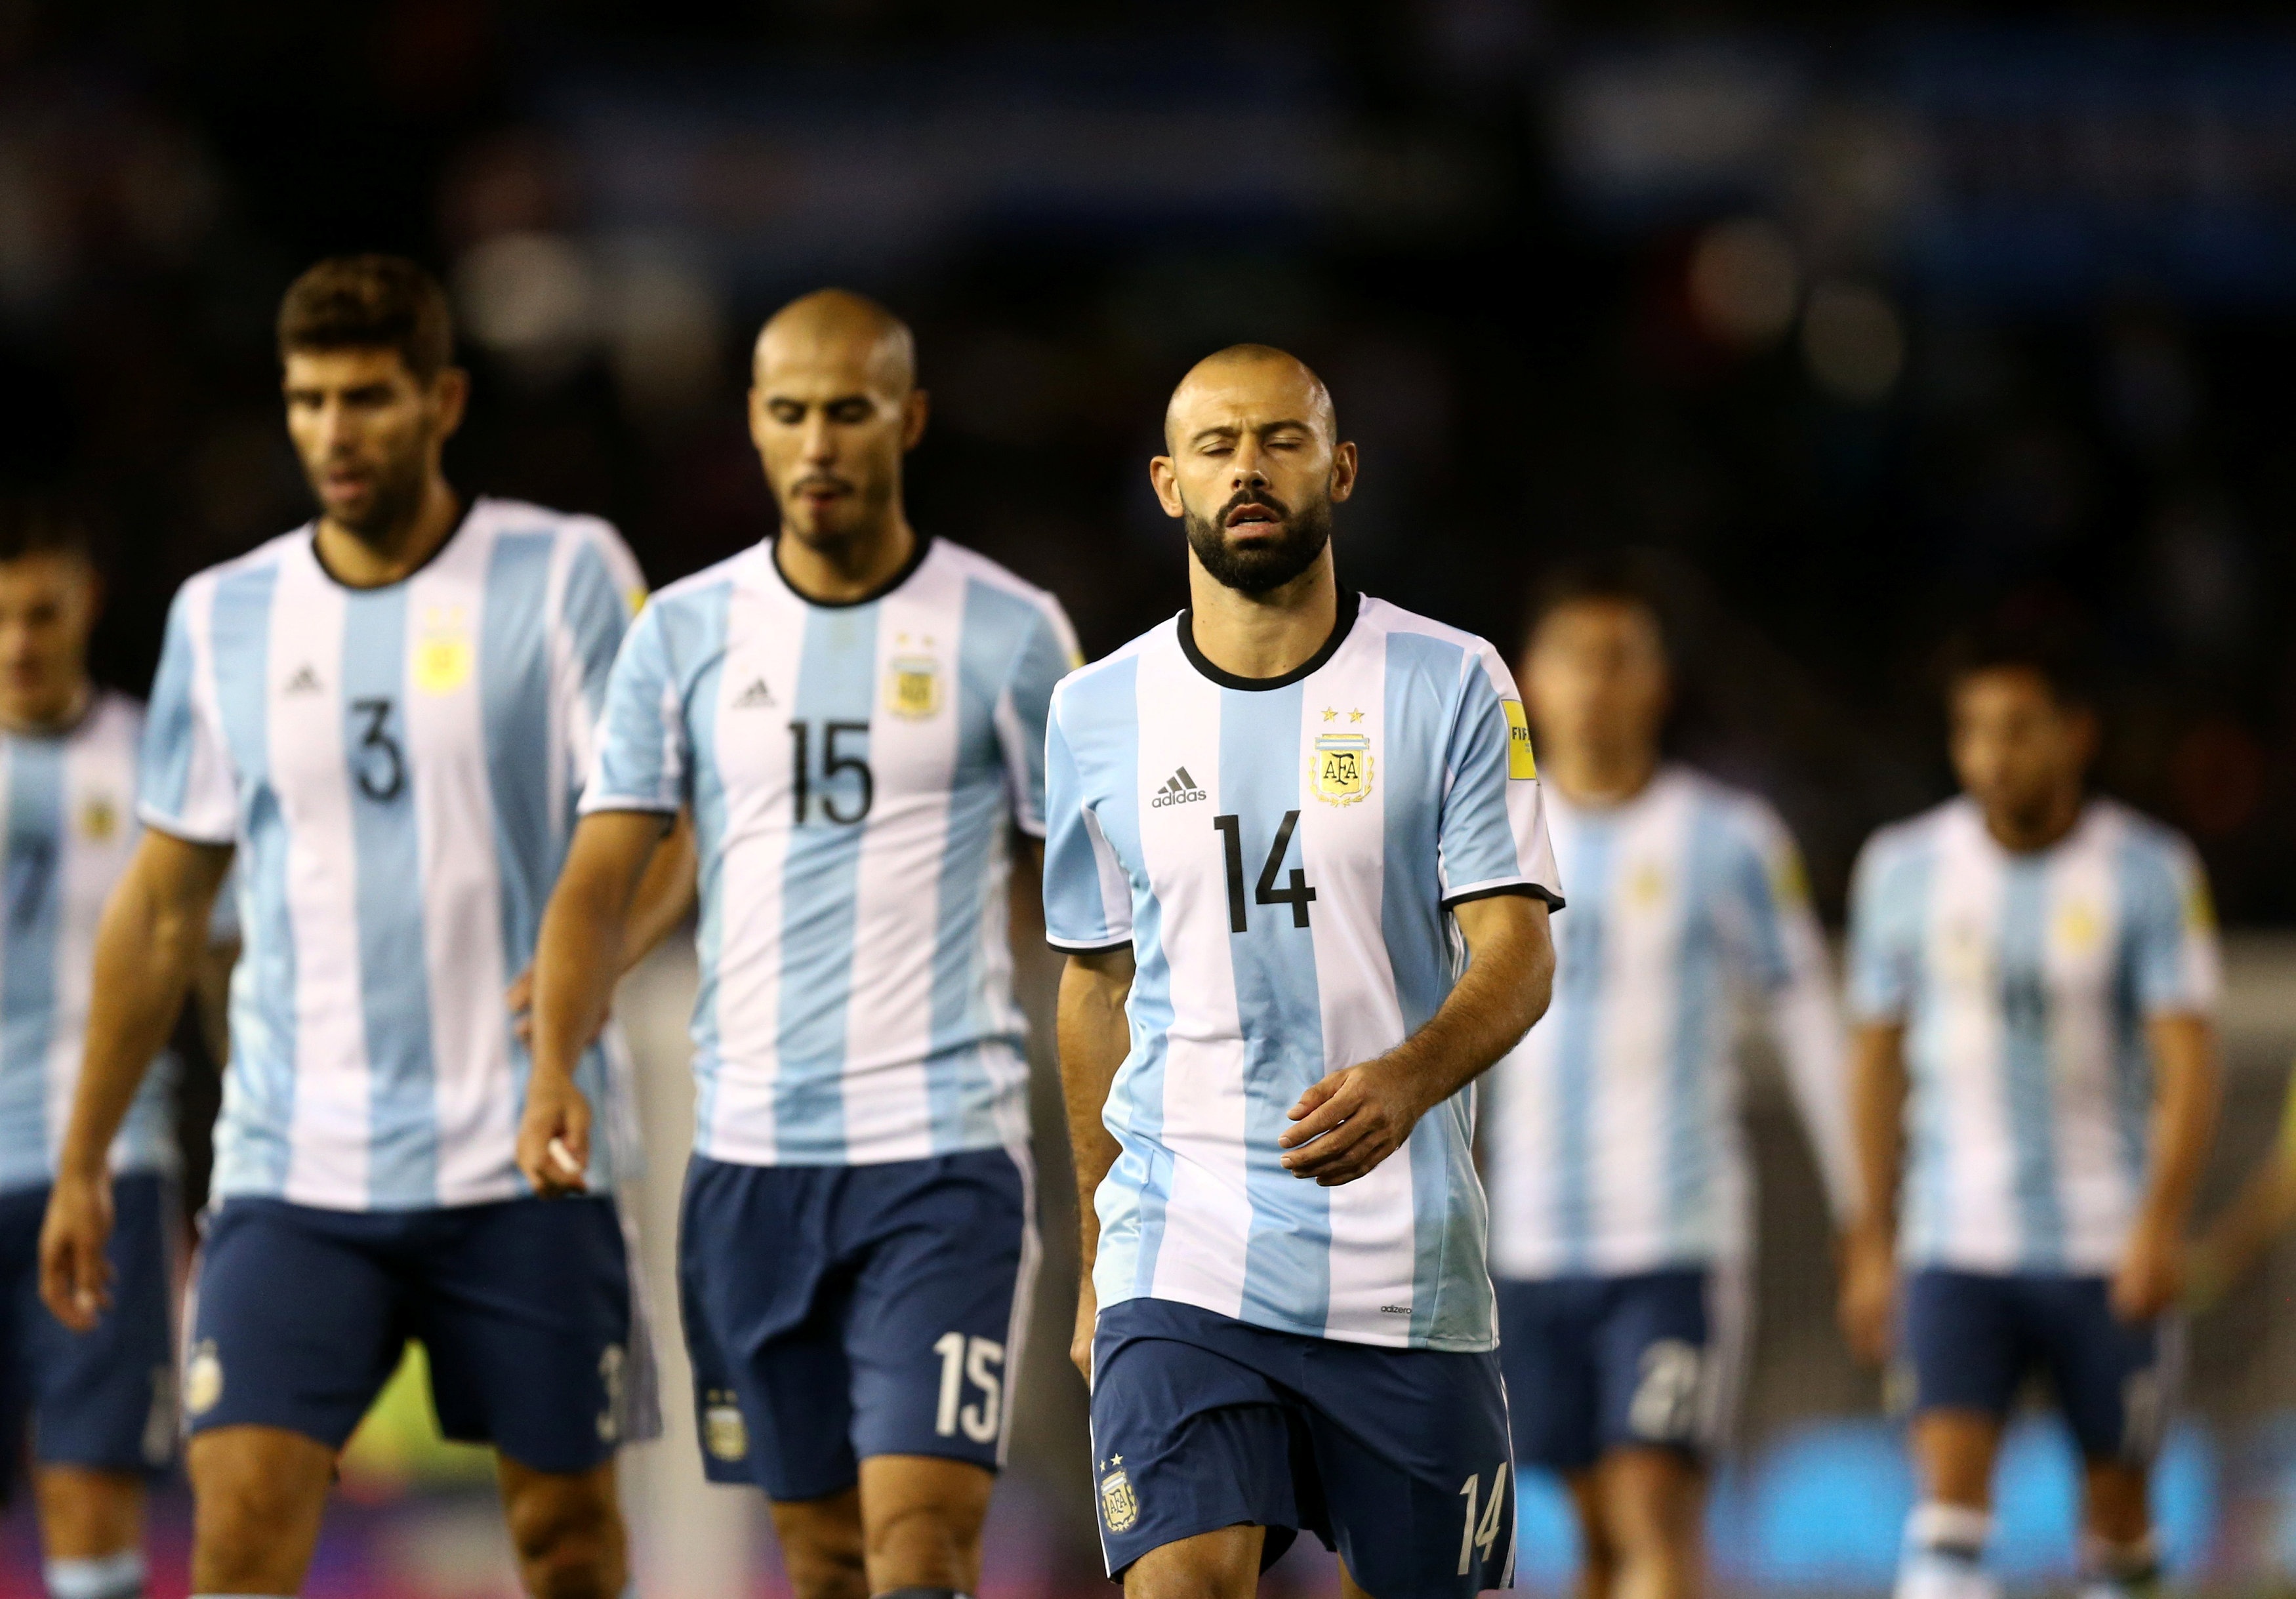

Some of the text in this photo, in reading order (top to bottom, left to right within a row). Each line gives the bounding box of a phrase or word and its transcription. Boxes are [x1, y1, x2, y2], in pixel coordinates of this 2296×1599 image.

[350, 699, 405, 803] 3
[789, 721, 874, 824] 15
[1323, 752, 1358, 785] AFA
[1511, 727, 1530, 740] FIF
[1152, 790, 1206, 808] adidas
[1214, 810, 1317, 933] 14
[1380, 1305, 1412, 1314] adizero
[933, 1331, 1005, 1444] 15
[1458, 1461, 1507, 1575] 14
